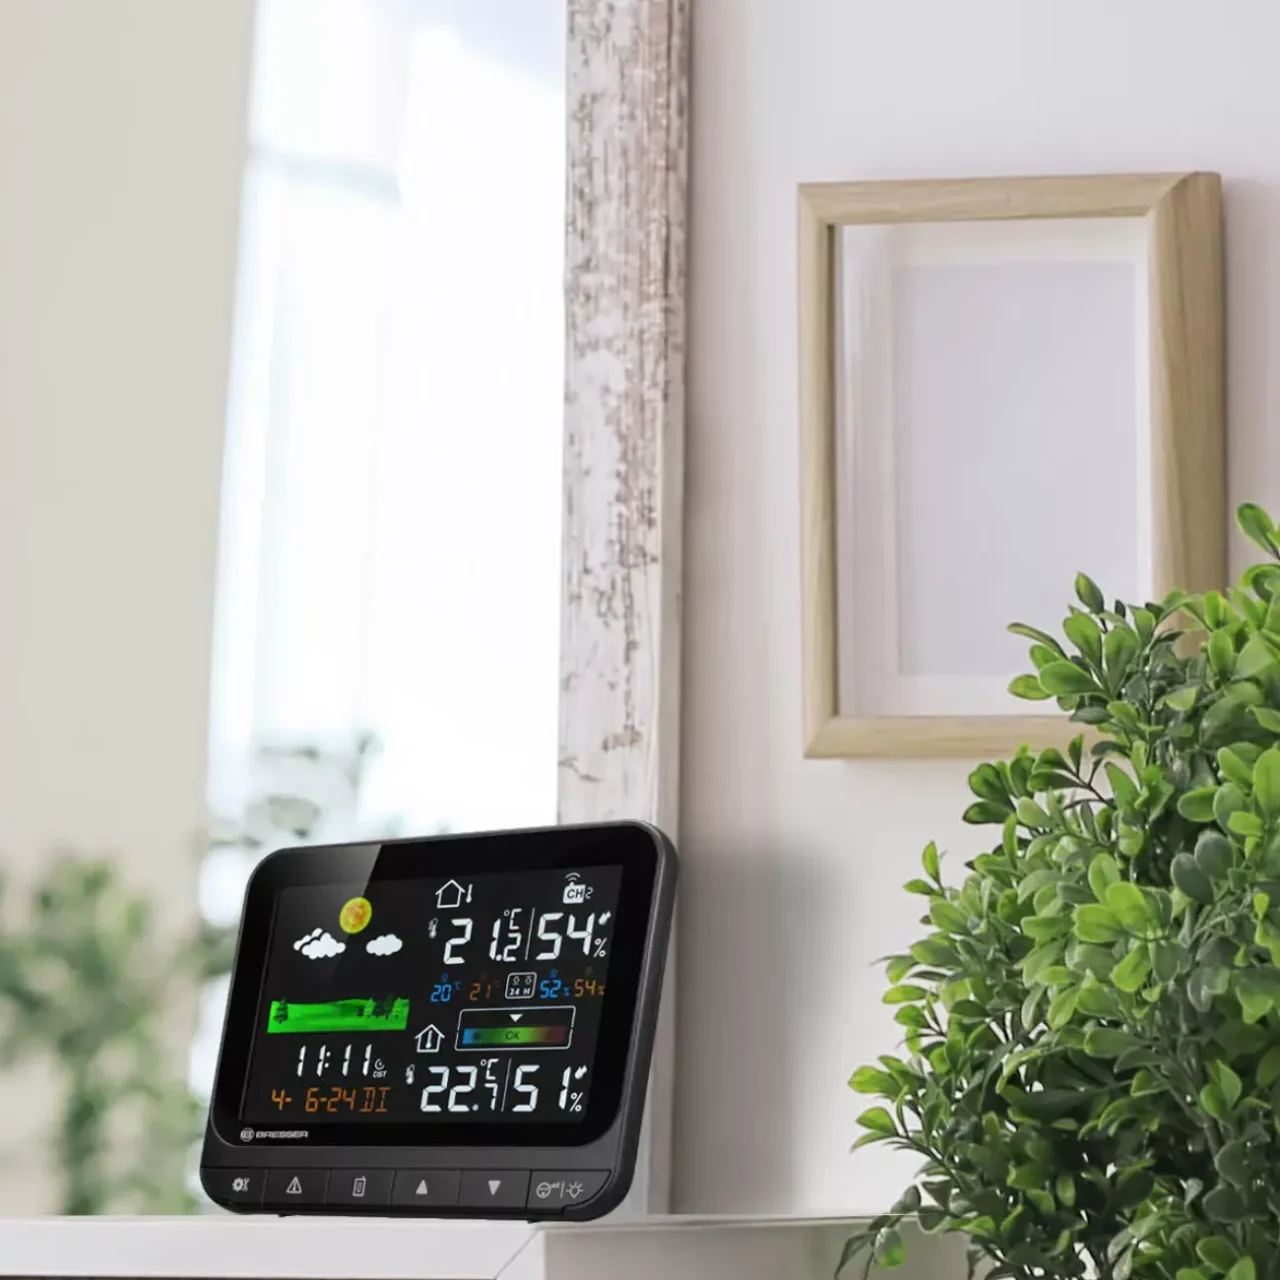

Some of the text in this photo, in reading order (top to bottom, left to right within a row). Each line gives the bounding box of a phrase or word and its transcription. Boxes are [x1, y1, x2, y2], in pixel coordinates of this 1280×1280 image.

[505, 1031, 520, 1041] OK
[297, 1044, 388, 1078] 11:11 DST
[255, 1130, 309, 1139] BRESSER
